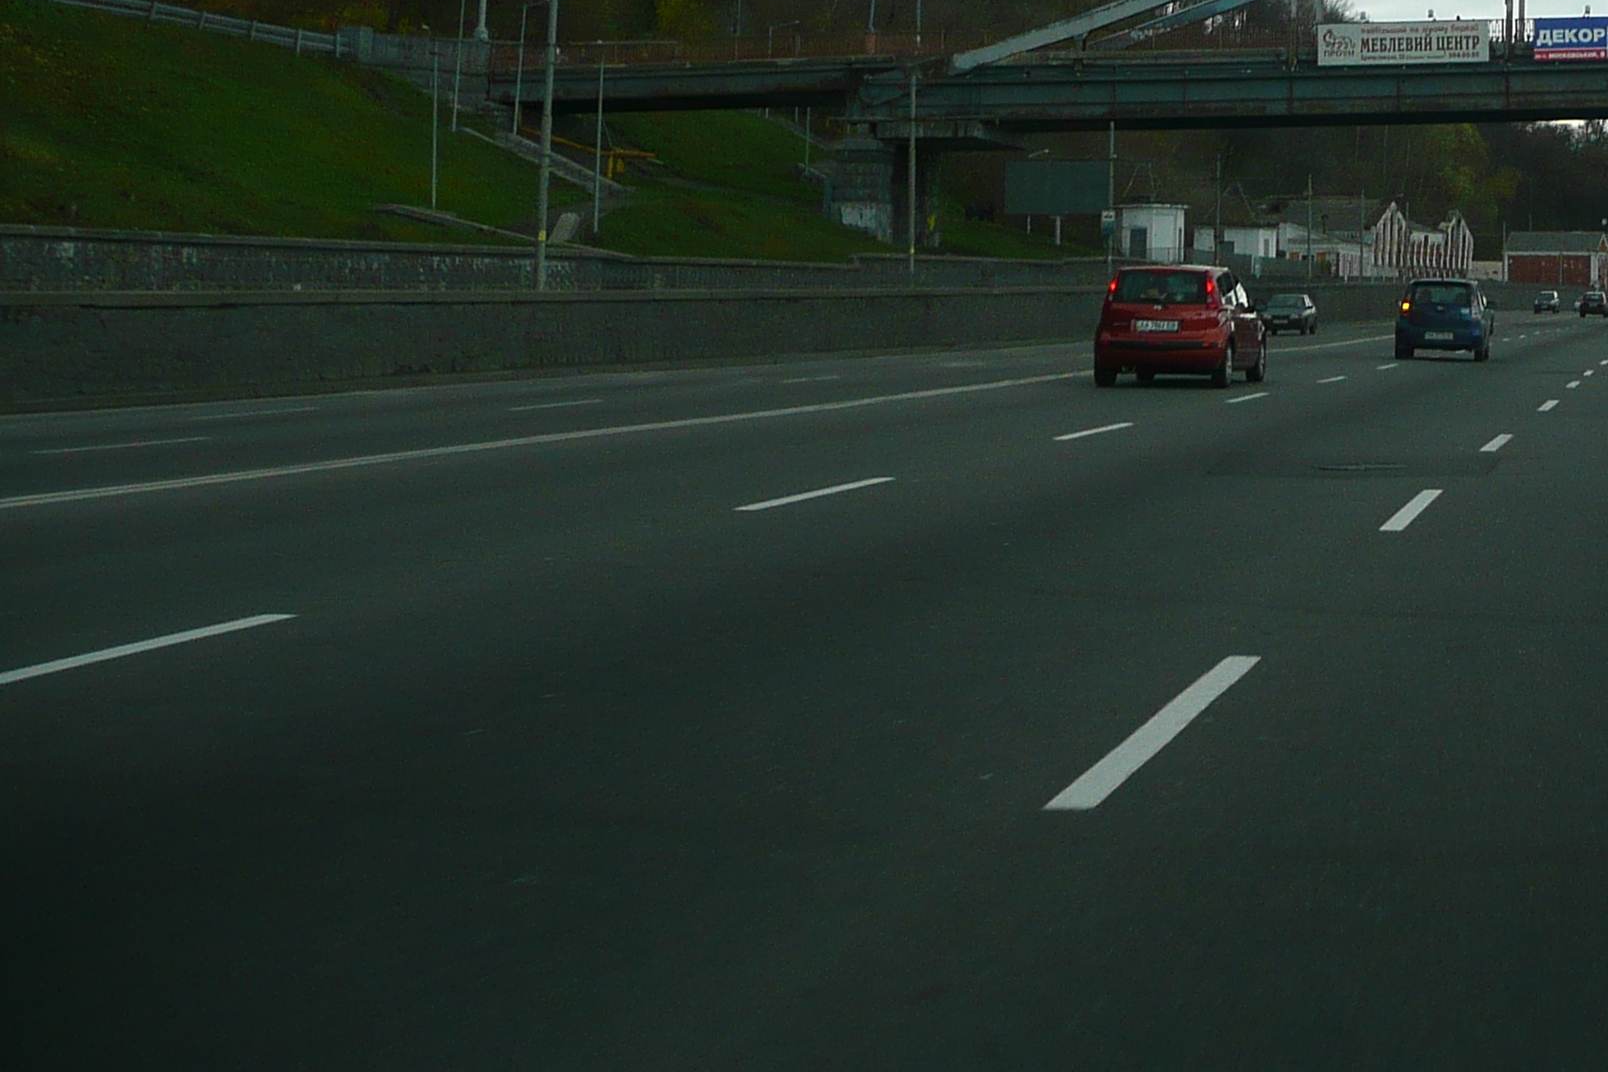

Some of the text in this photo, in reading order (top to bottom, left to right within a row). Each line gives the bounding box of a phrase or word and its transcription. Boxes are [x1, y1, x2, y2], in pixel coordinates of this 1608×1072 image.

[1360, 34, 1480, 54] МЕБЛЕВИЙ ЦЕНТР
[1536, 28, 1606, 46] ДЕКОР
